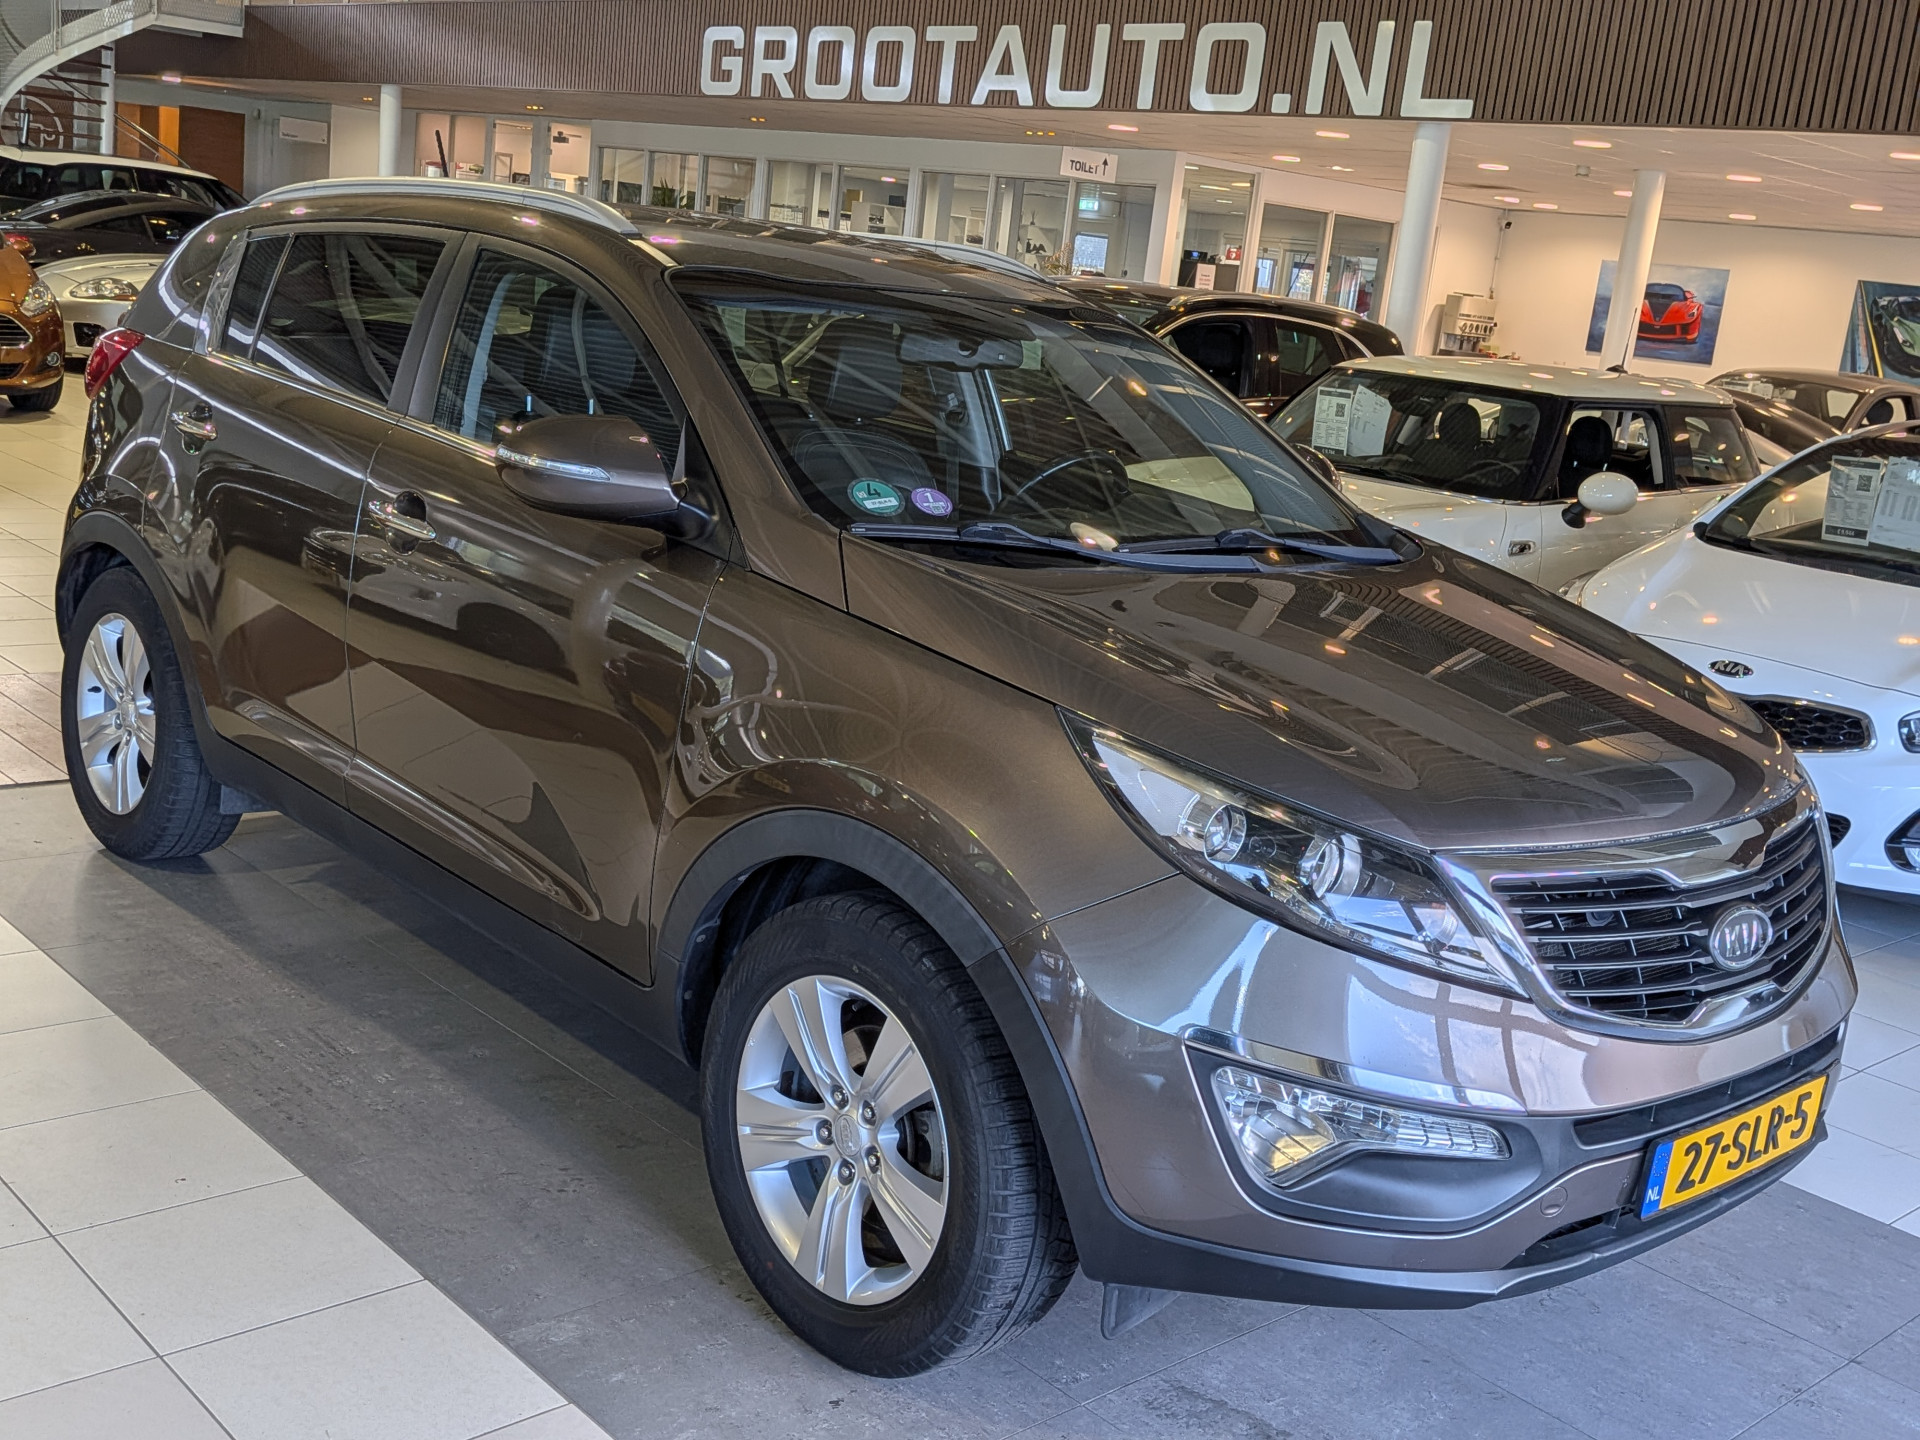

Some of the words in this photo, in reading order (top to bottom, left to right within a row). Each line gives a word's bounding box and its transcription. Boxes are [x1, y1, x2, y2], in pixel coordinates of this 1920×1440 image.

[700, 20, 1474, 119] GROOTAUTO.NL
[1069, 159, 1099, 175] TOILET
[867, 483, 881, 497] 4
[1713, 661, 1745, 676] KIA
[1674, 1090, 1813, 1194] 27-SLR-5
[1646, 1188, 1661, 1204] NL
